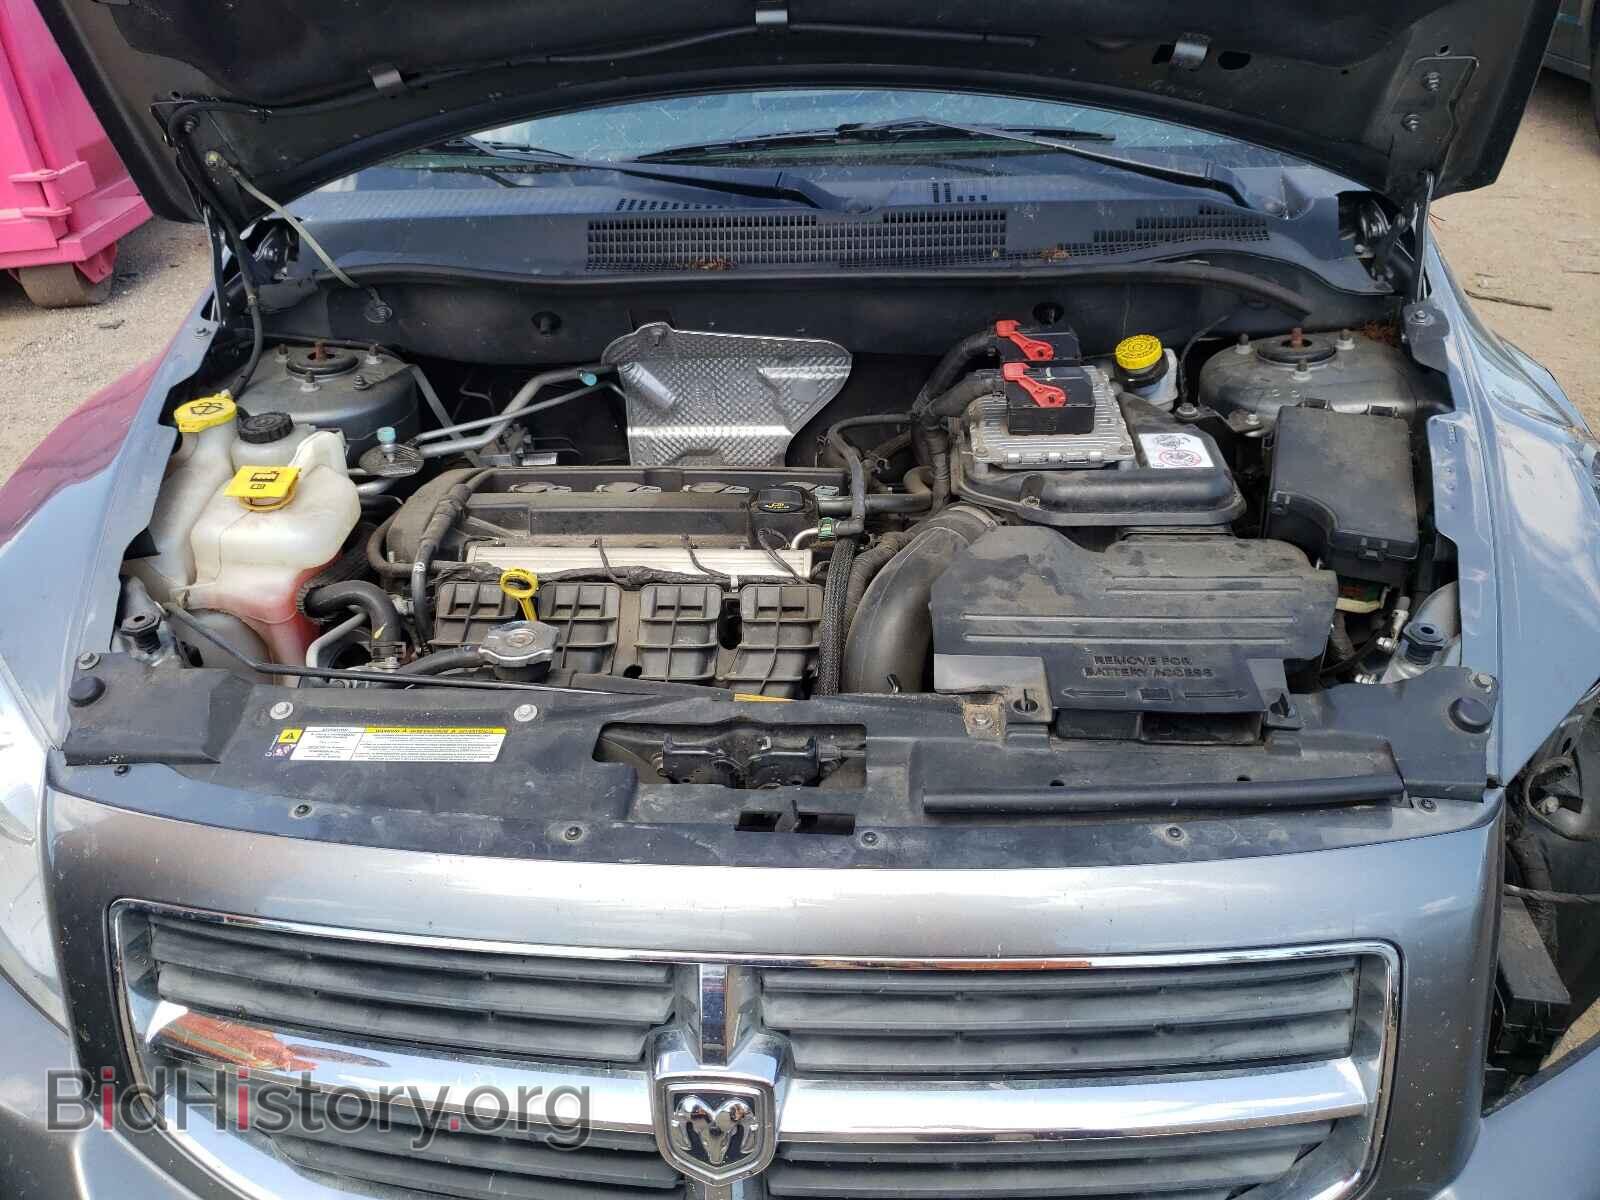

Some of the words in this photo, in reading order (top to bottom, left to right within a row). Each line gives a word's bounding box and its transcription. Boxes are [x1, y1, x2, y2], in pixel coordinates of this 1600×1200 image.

[1093, 655, 1158, 666] REMOVE
[1161, 655, 1193, 666] FOR
[1084, 667, 1147, 678] BATTERY
[1152, 667, 1215, 678] ACCESS
